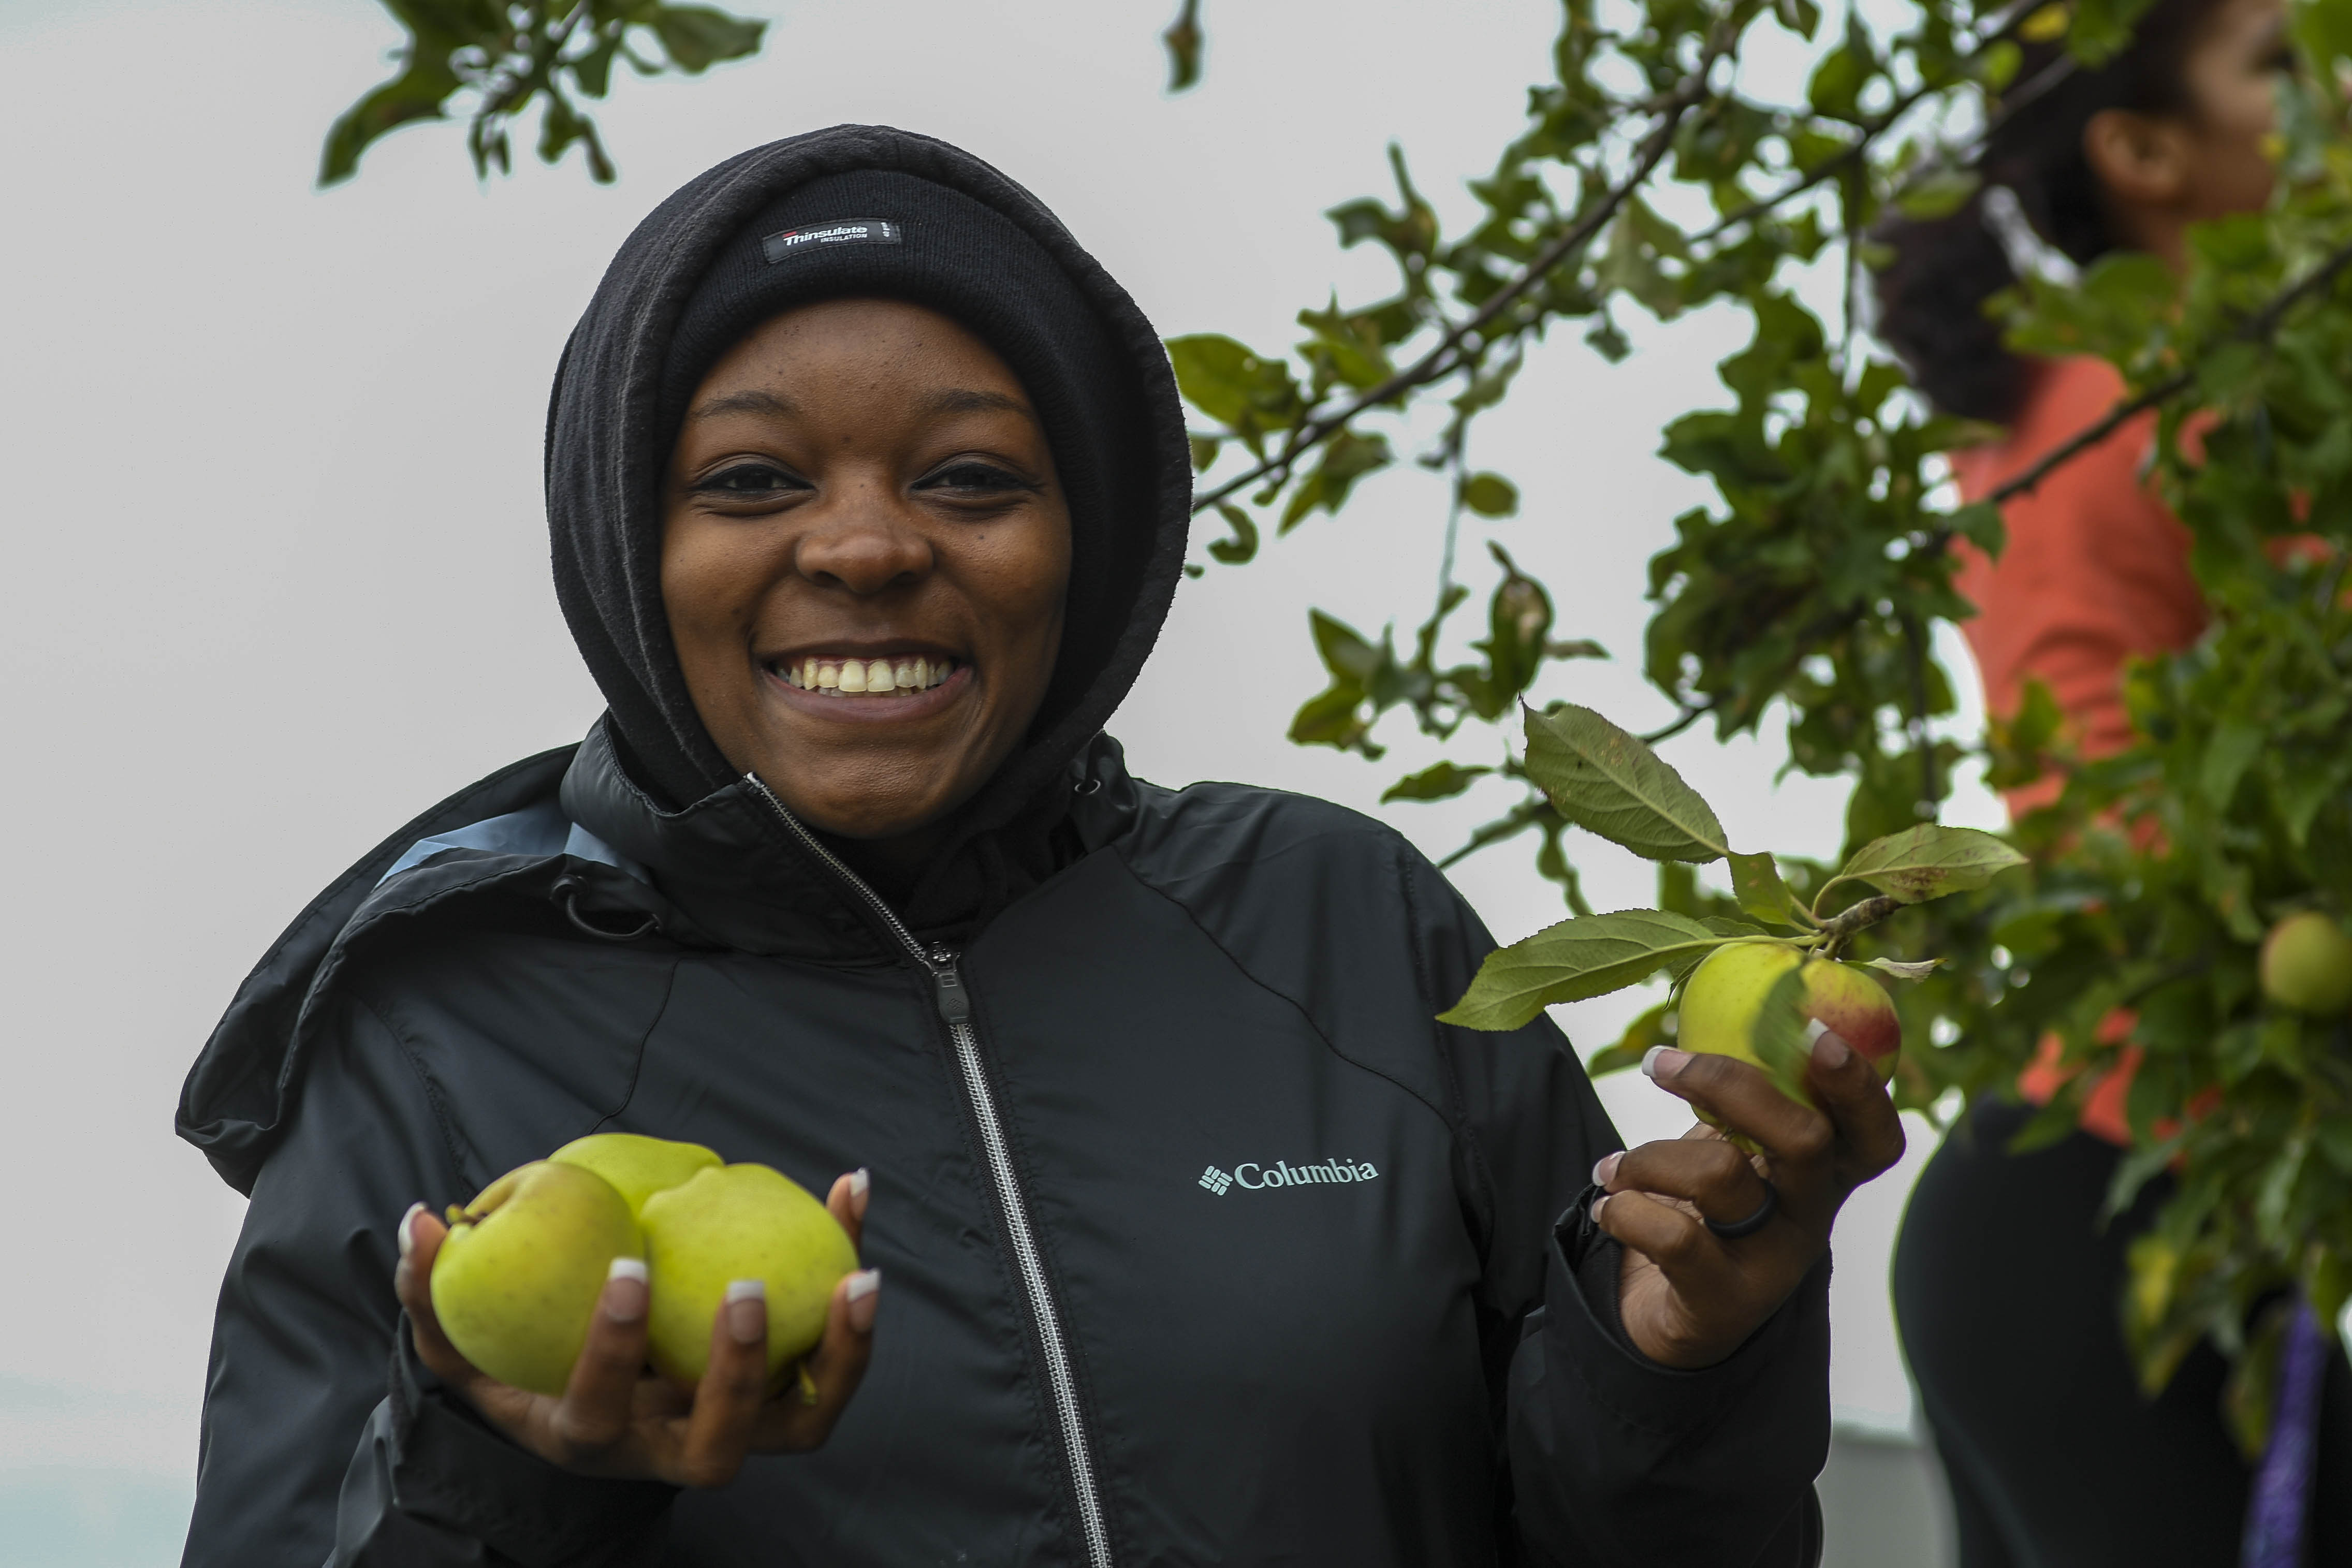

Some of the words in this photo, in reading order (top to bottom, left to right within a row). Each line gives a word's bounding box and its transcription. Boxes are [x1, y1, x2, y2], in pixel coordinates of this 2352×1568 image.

[783, 227, 867, 245] Thinsulate
[821, 233, 867, 243] INSULATION
[1234, 1158, 1379, 1189] Columbia
